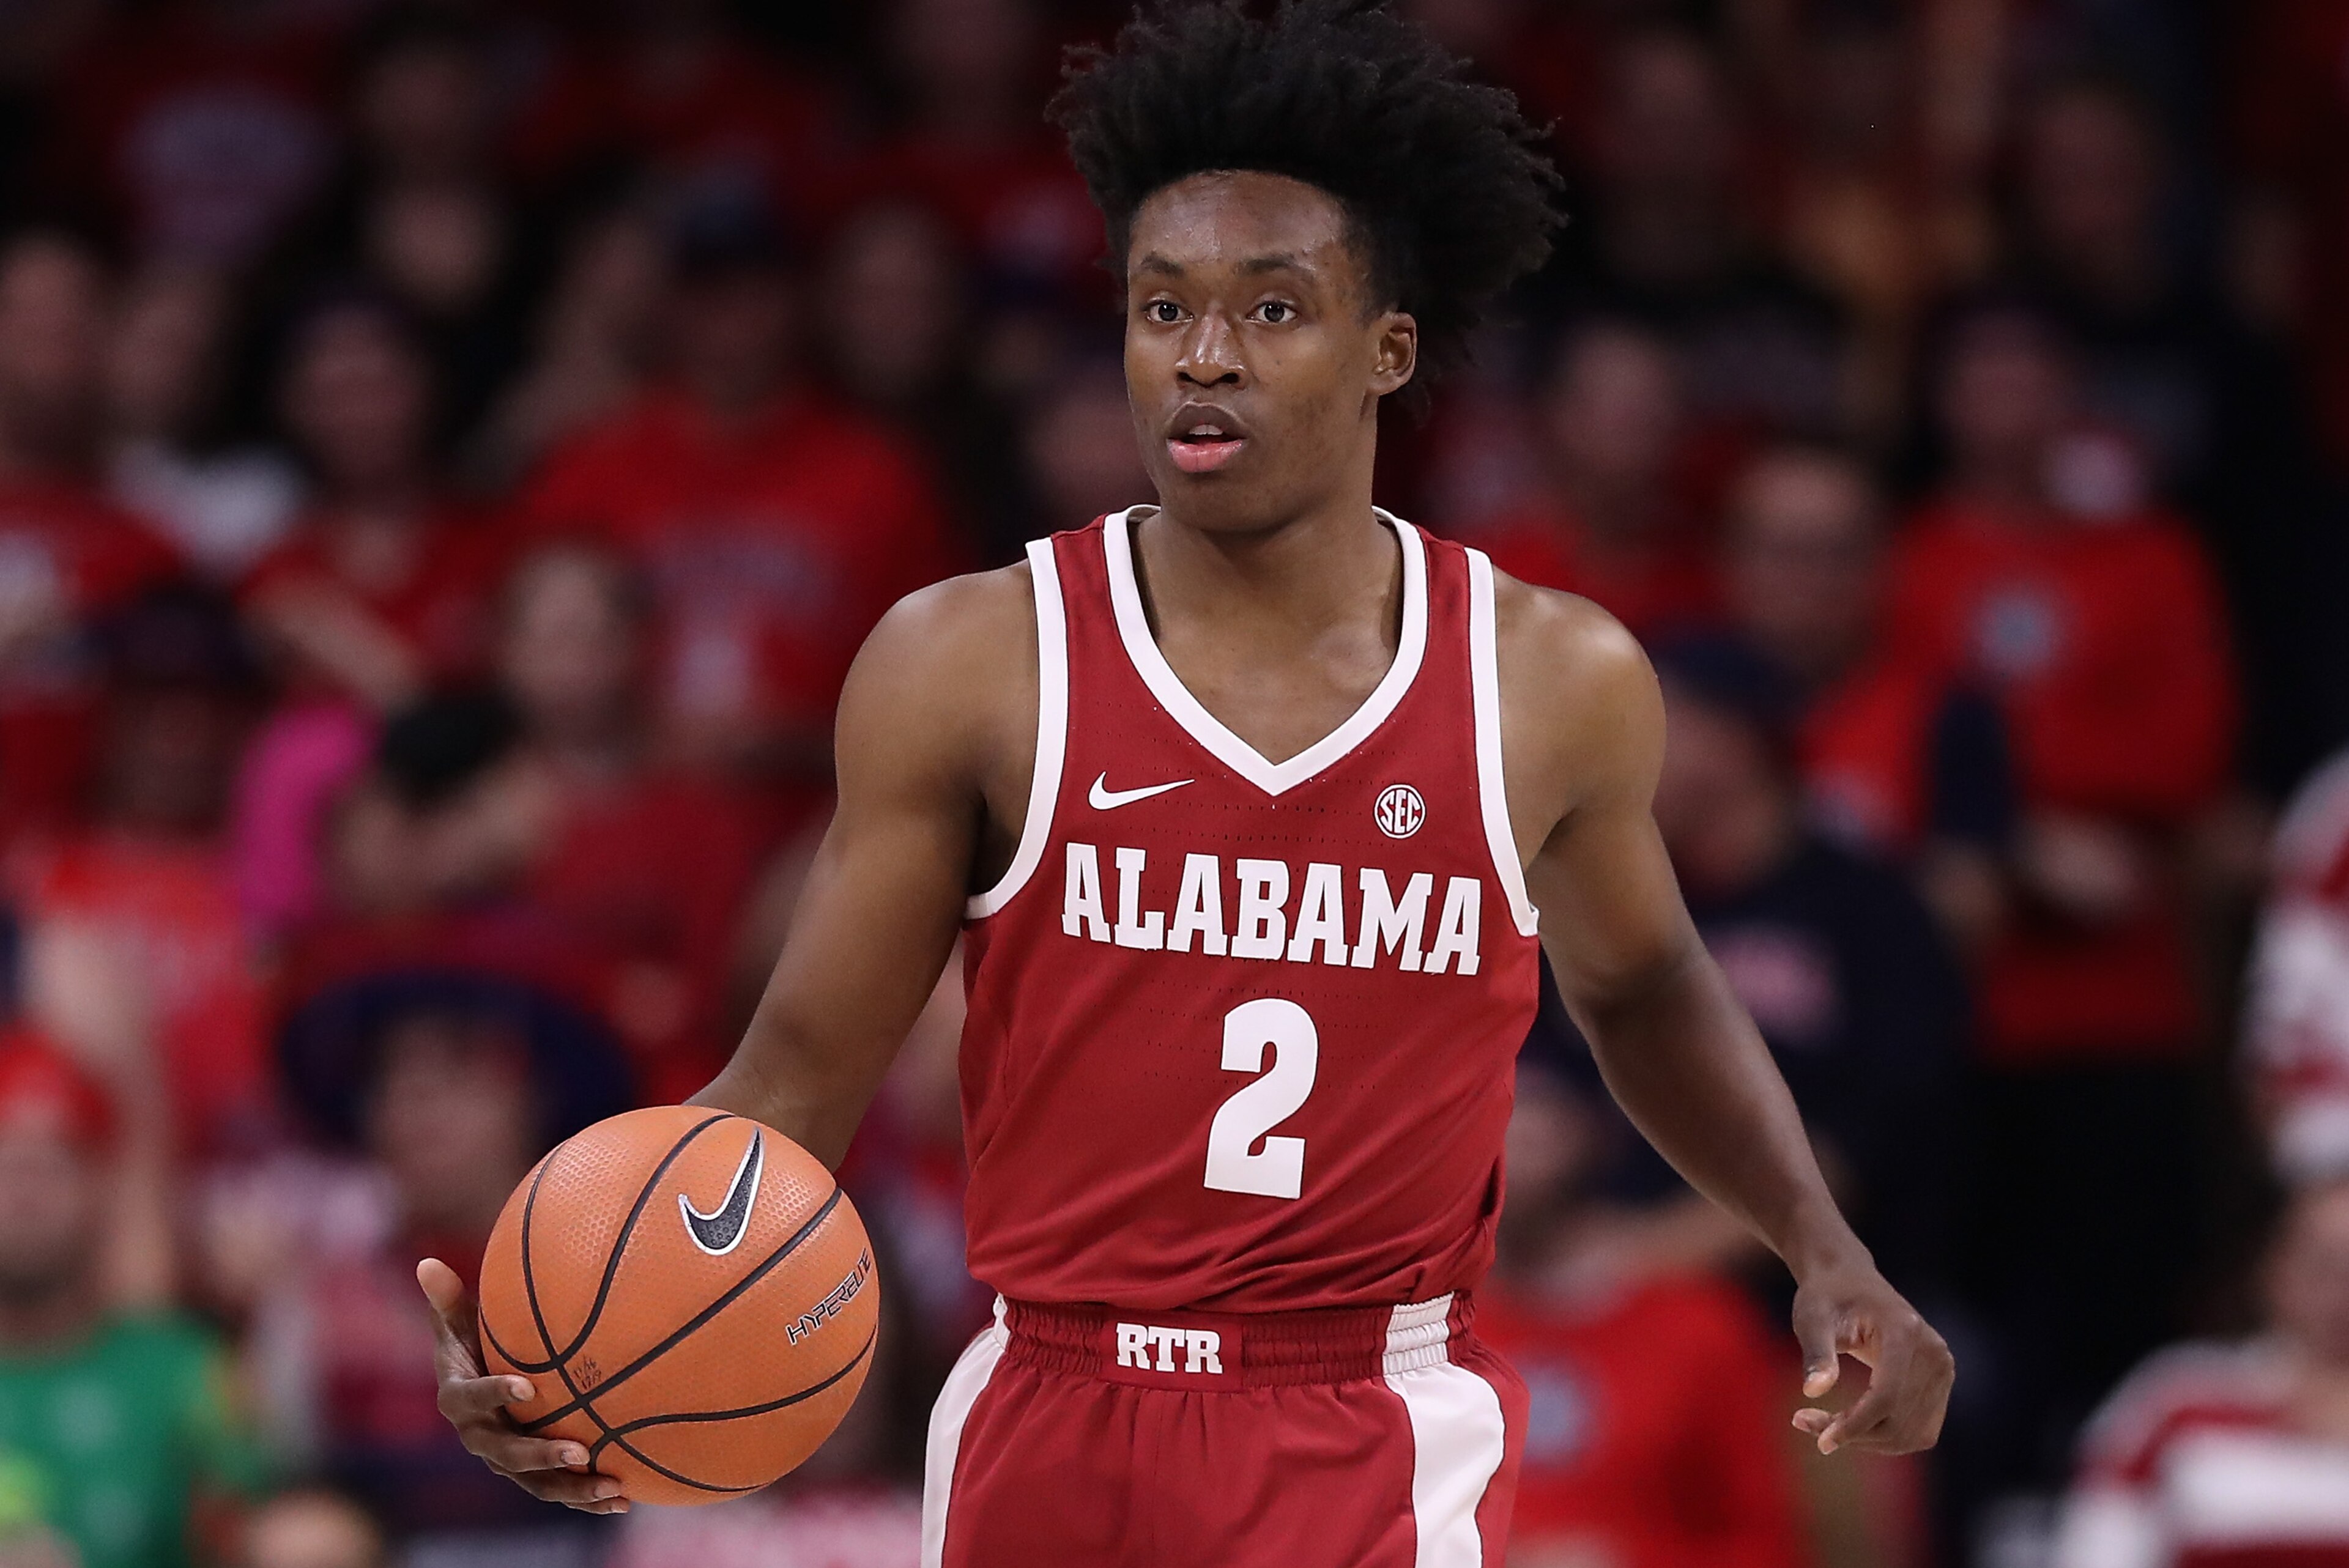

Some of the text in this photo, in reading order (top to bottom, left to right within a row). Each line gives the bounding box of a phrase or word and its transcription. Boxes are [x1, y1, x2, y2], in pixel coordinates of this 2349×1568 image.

[1380, 790, 1421, 833] SEC
[1061, 842, 1481, 975] ALABAMA
[1203, 998, 1318, 1199] 2
[1116, 1323, 1223, 1374] RTR
